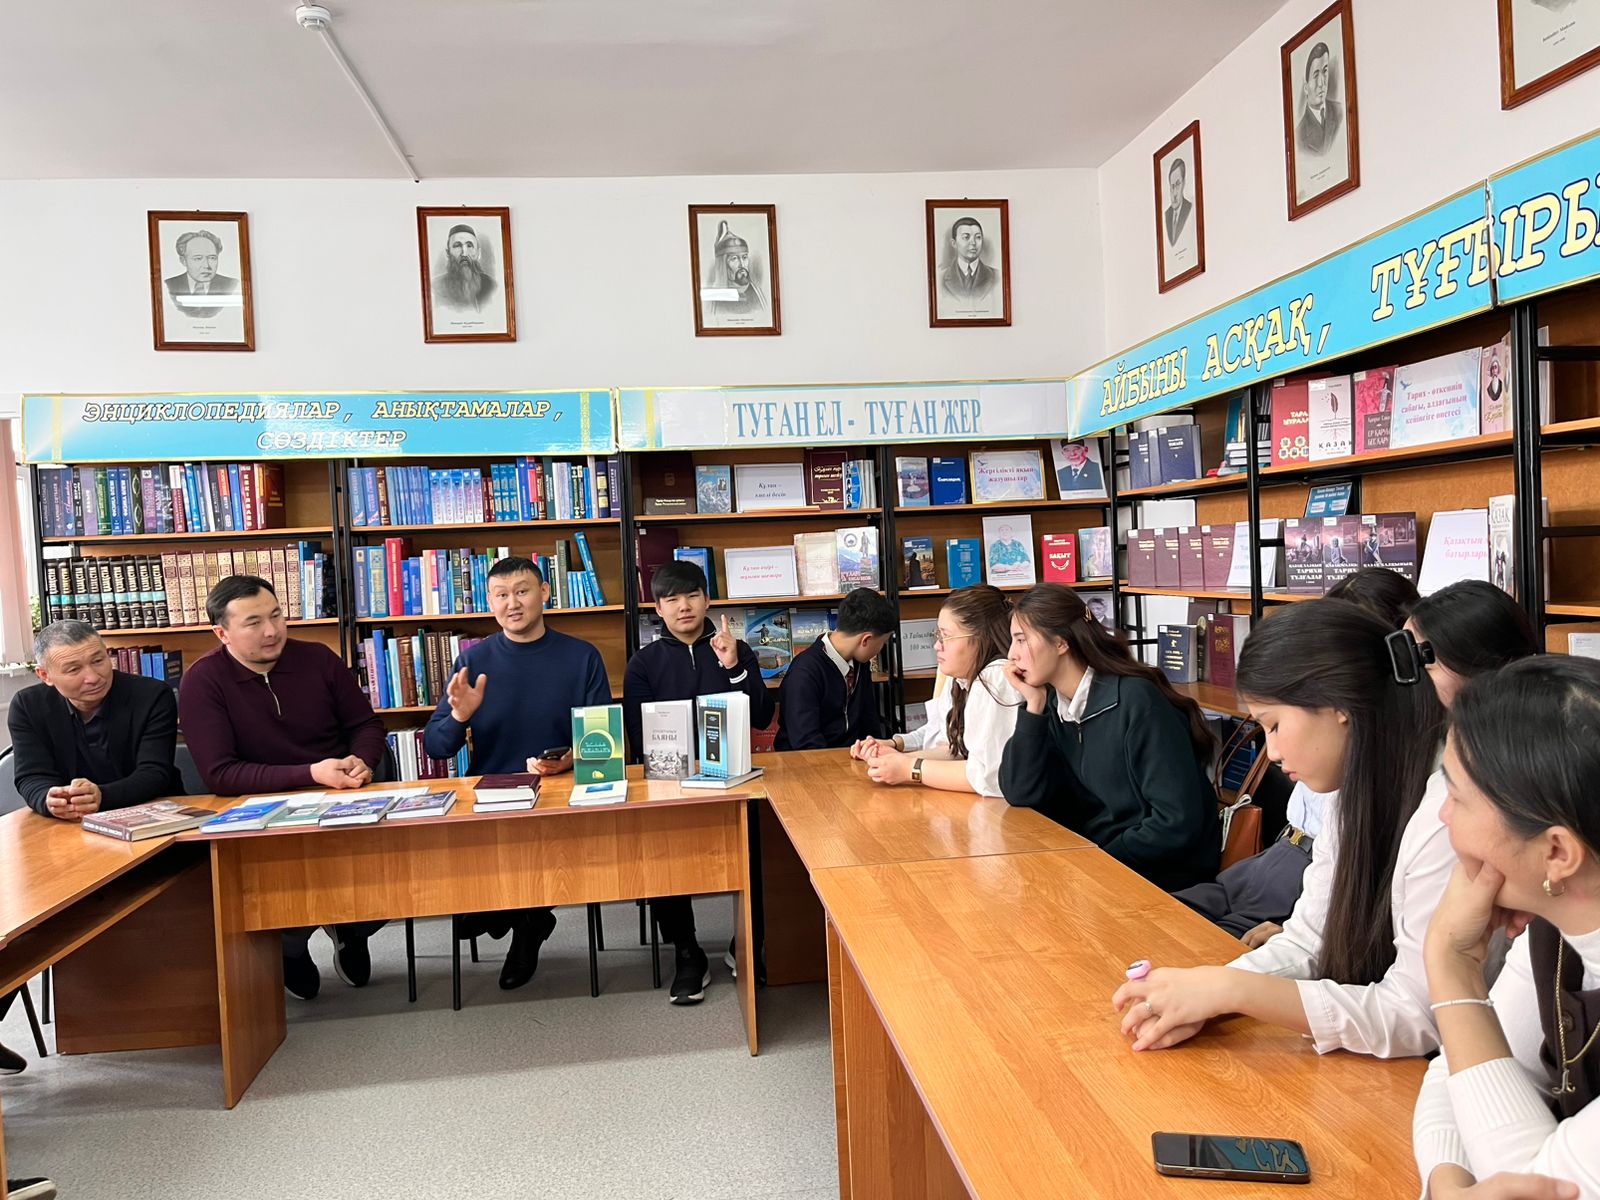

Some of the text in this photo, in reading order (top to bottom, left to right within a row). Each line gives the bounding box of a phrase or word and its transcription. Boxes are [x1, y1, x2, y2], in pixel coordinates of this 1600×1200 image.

[1099, 347, 1188, 418] АЙБЫНЫ
[1200, 293, 1332, 381] АСҚАҚ,
[1406, 390, 1427, 401] Тарих
[82, 400, 563, 424] ЭНЦИКЛОПЕДИЯЛАР, АНЫҚТАМАЛАР,
[732, 401, 812, 438] ТУҒАН
[815, 402, 844, 437] ЕЛ
[864, 400, 938, 436] ТУҒАН
[943, 398, 982, 435] ЖЕР
[256, 430, 408, 452] СӨЗДІКТЕР
